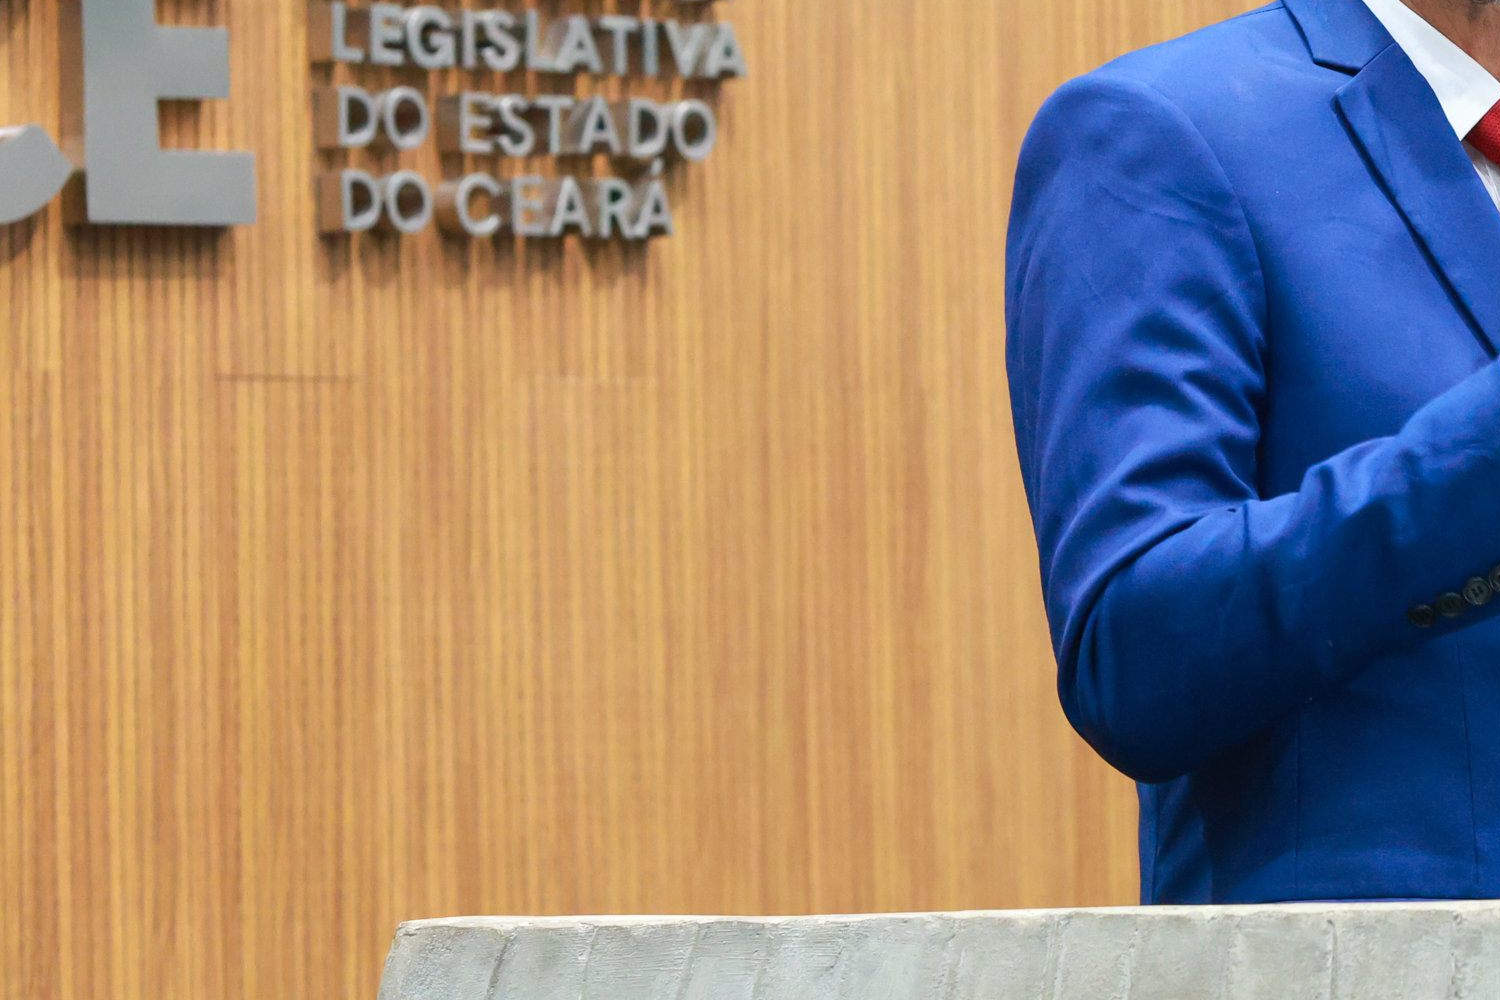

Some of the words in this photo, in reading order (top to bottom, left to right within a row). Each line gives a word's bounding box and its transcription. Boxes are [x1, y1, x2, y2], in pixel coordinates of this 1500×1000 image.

[331, 0, 747, 78] LEGISLATIVA
[338, 86, 431, 150] DO
[459, 91, 717, 161] ESTADO
[341, 168, 433, 233] DO
[455, 157, 674, 239] CEARÁ
